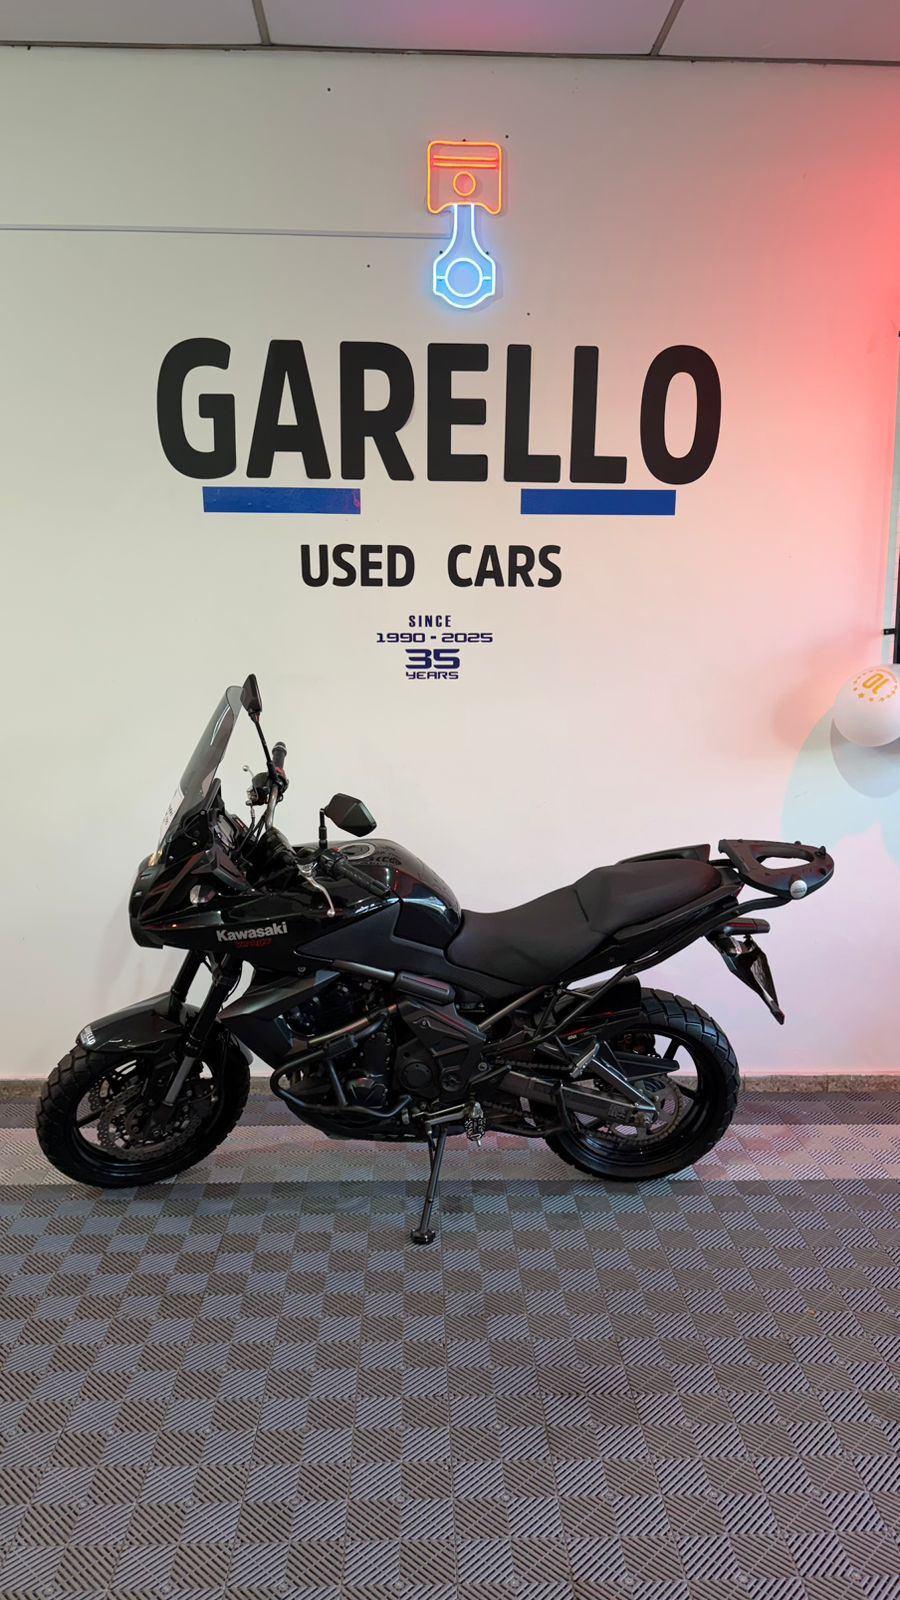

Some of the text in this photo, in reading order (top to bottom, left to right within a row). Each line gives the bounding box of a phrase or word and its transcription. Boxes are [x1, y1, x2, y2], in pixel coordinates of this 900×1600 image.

[157, 337, 722, 485] GARELLO
[301, 544, 562, 587] USED CARS
[408, 615, 452, 628] SINCE
[376, 633, 426, 643] 1990
[441, 633, 493, 643] 2025
[405, 649, 461, 669] 35
[405, 671, 459, 680] YEARS
[216, 921, 288, 941] Kawasaki
